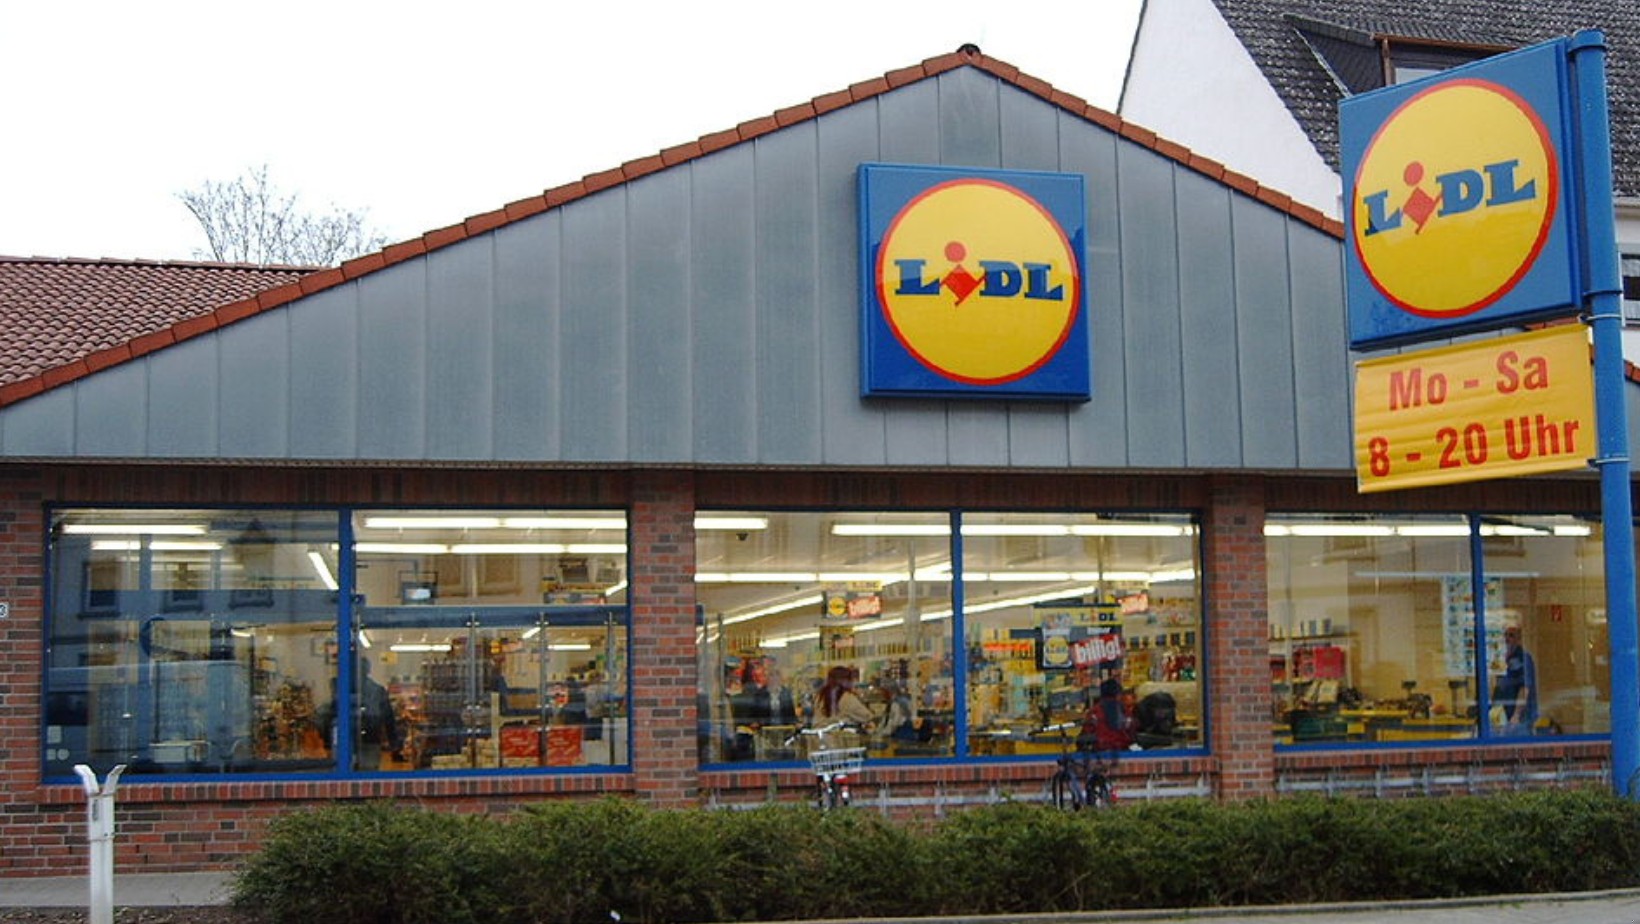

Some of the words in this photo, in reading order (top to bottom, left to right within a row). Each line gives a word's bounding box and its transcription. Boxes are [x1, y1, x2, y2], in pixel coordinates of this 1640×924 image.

[1363, 159, 1536, 237] LIDL
[894, 241, 1063, 306] LIDL
[1389, 368, 1447, 411] Mo
[1496, 350, 1549, 394] Sa
[1368, 436, 1390, 477] 8
[1436, 422, 1487, 469] 20
[1504, 413, 1579, 461] Uhr
[1073, 634, 1121, 663] billig!
